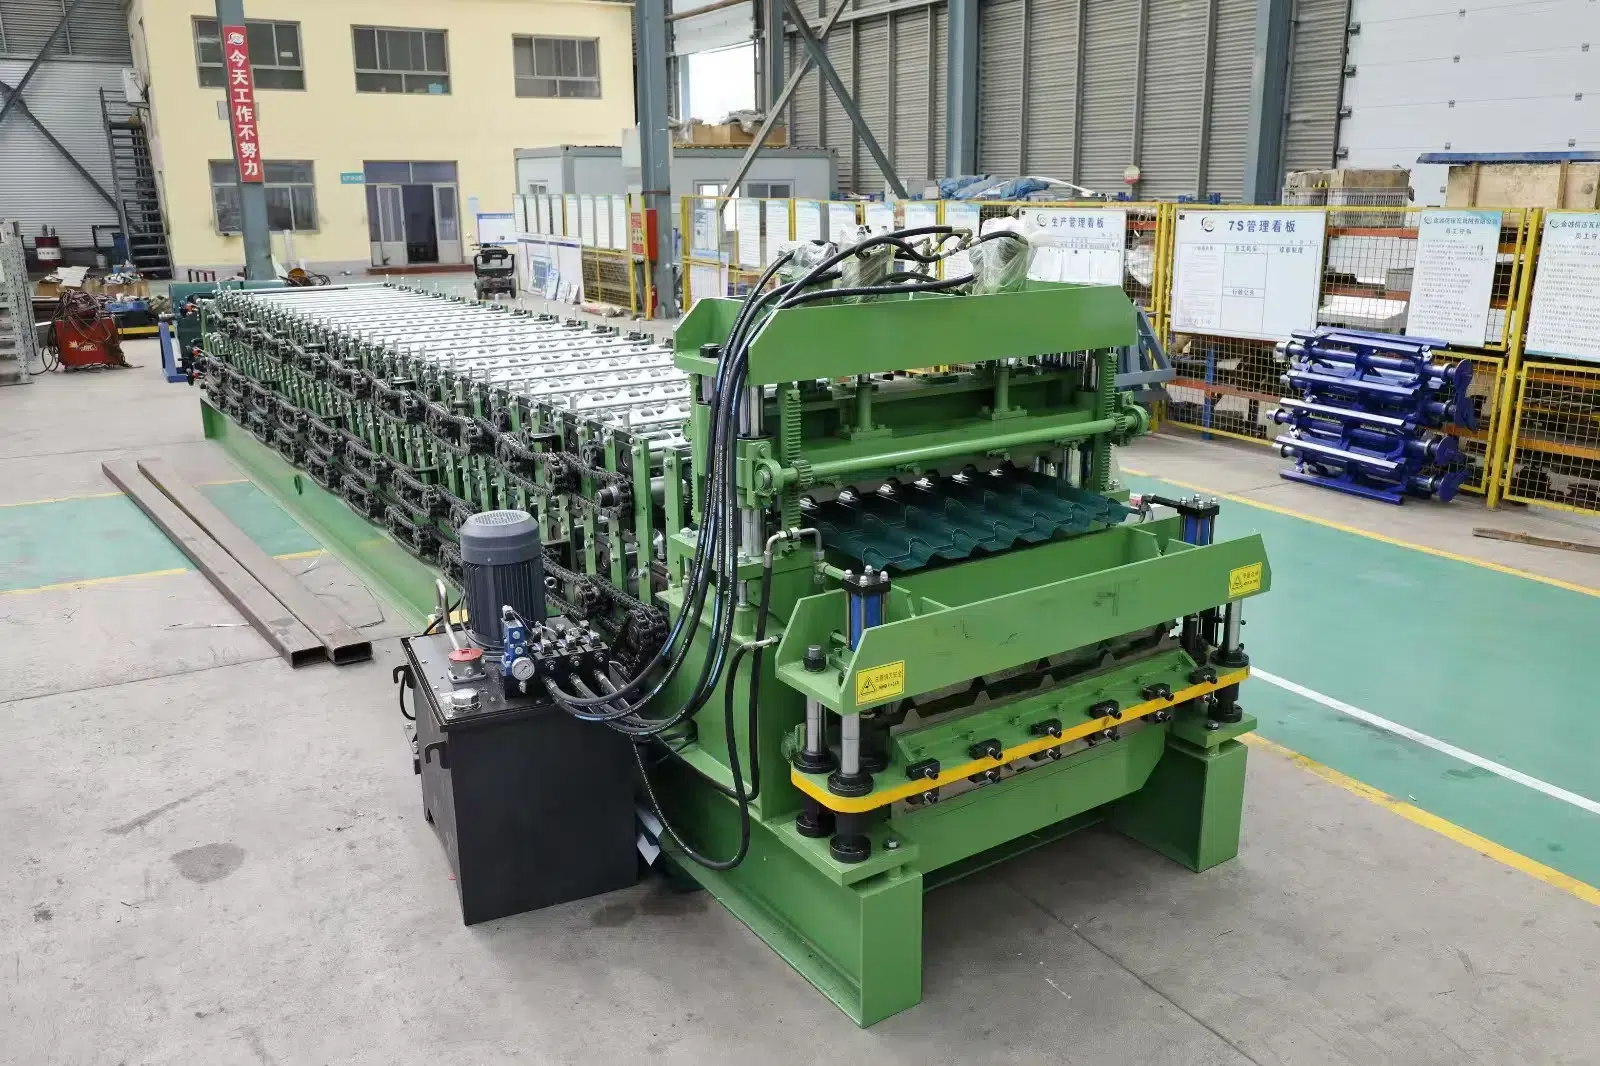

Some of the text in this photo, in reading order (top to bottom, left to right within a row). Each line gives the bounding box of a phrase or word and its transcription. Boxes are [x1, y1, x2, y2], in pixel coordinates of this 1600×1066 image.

[229, 50, 258, 176] 今天工作不努力
[1051, 216, 1104, 229] 生产管理看板
[1228, 220, 1296, 233] 7S管理看板
